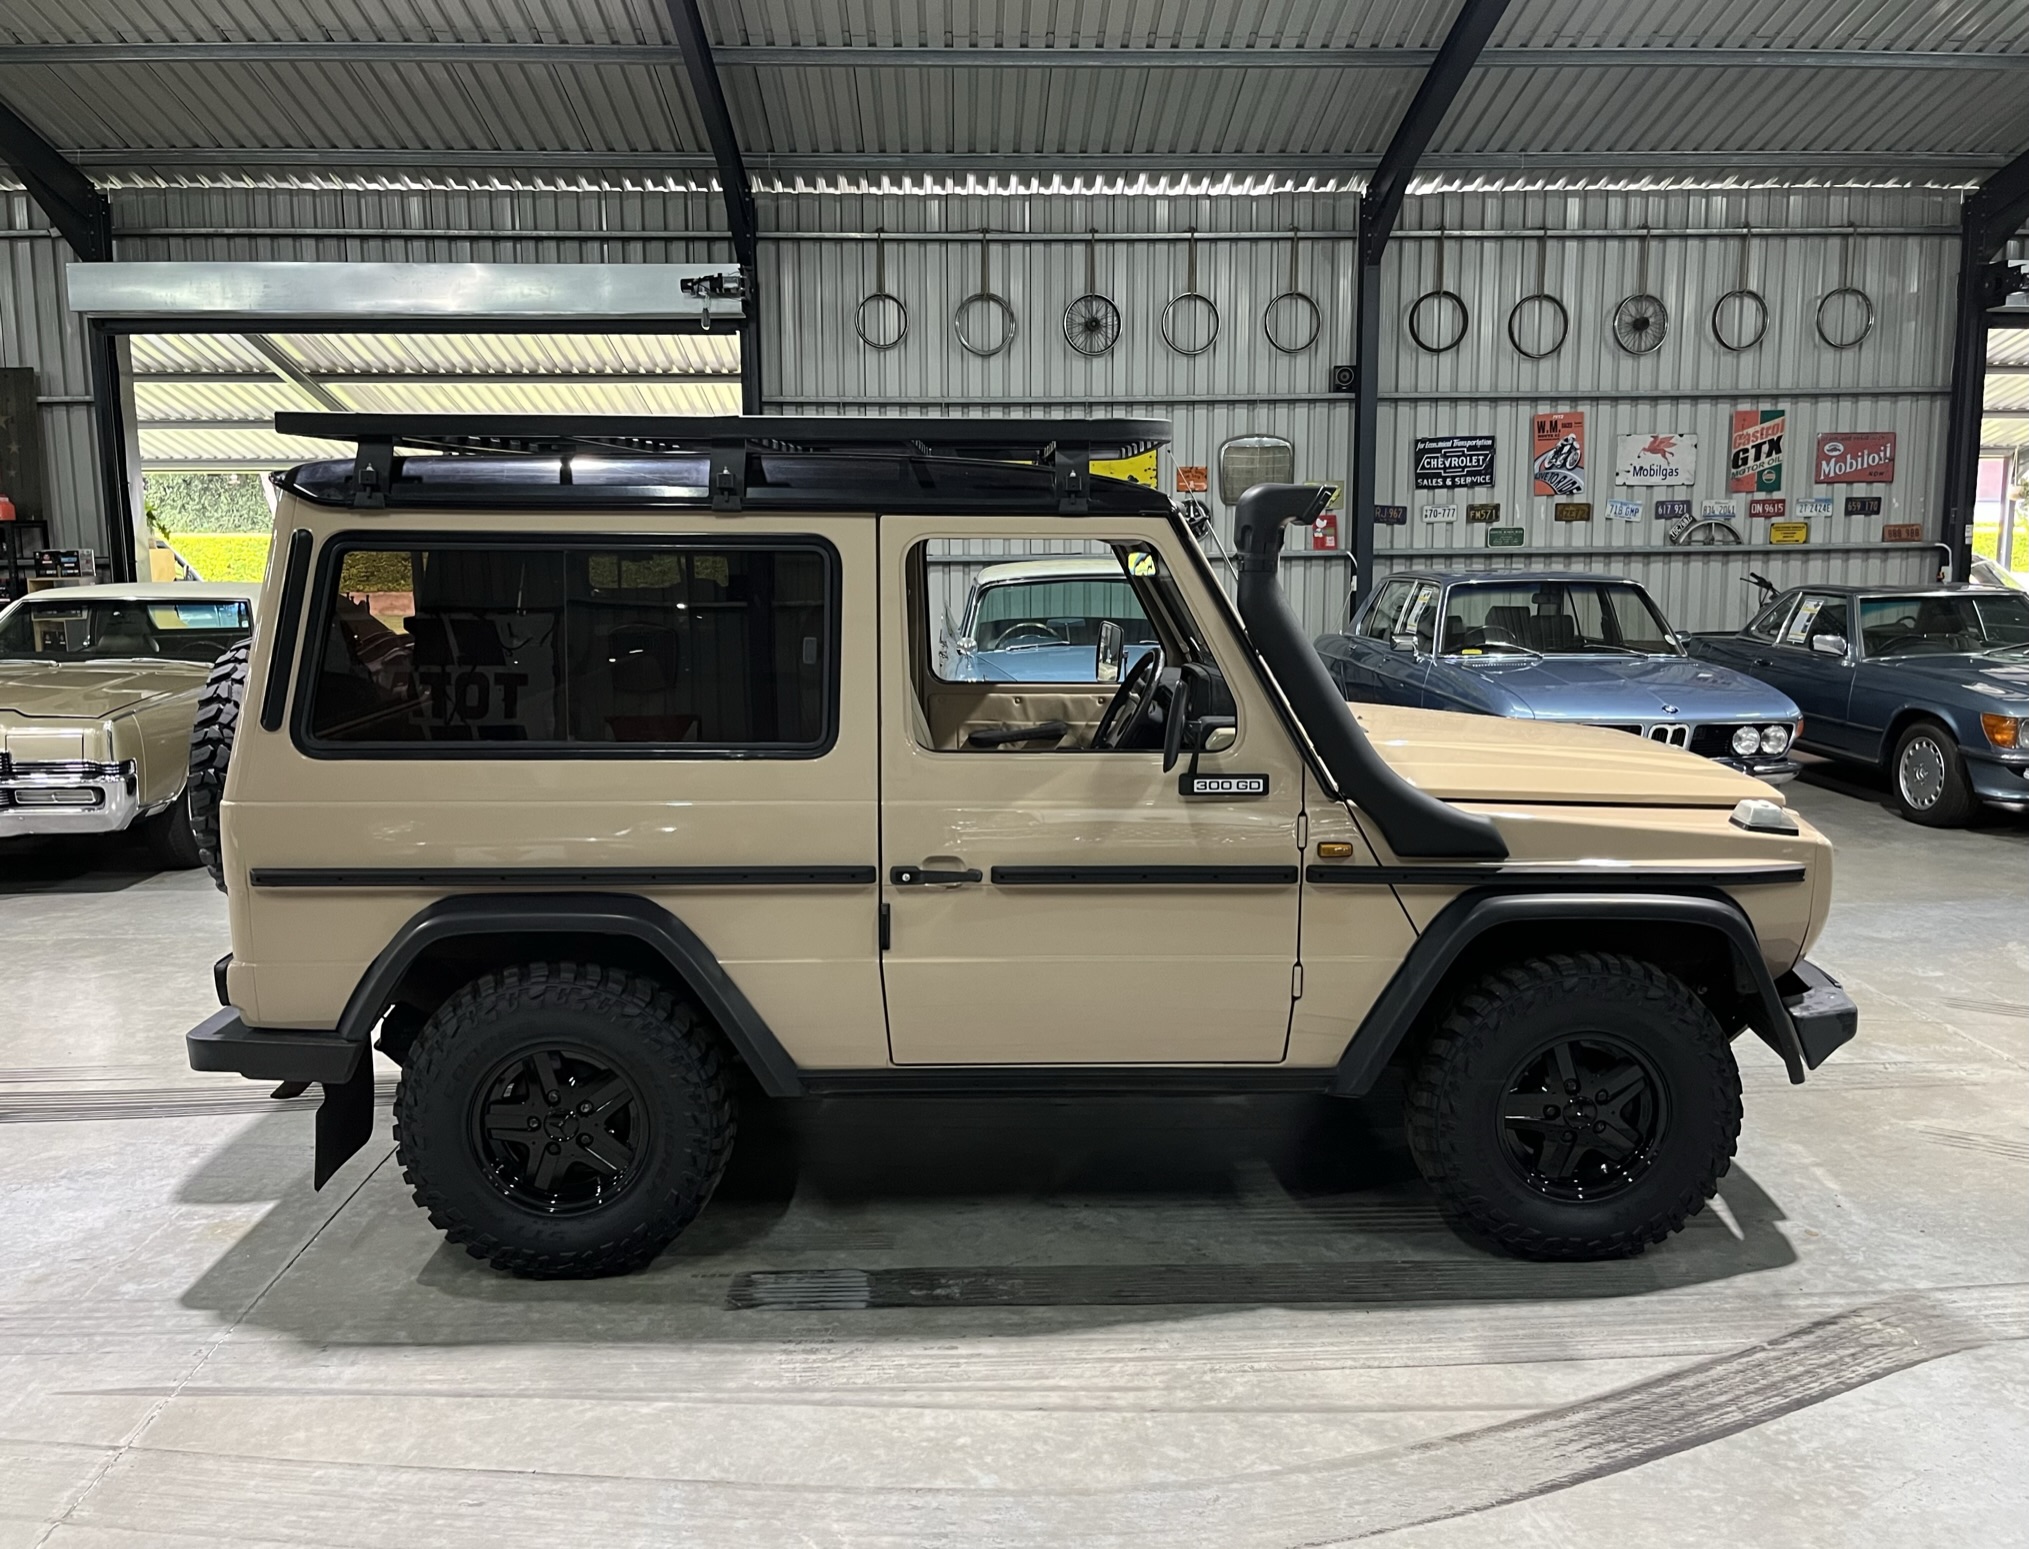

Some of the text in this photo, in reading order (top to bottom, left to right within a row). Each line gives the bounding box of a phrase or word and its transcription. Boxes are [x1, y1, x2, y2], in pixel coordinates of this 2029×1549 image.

[1733, 418, 1786, 450] Castrol
[1732, 434, 1783, 470] GTX
[1424, 456, 1485, 468] CHEVROLET
[1731, 461, 1765, 480] MOTOR
[1767, 456, 1783, 466] OIL
[1632, 464, 1679, 480] Mobilgas
[1417, 475, 1491, 487] SALES & SERVICE
[1764, 503, 1784, 514] 9615
[1196, 781, 1261, 790] 300 GD
